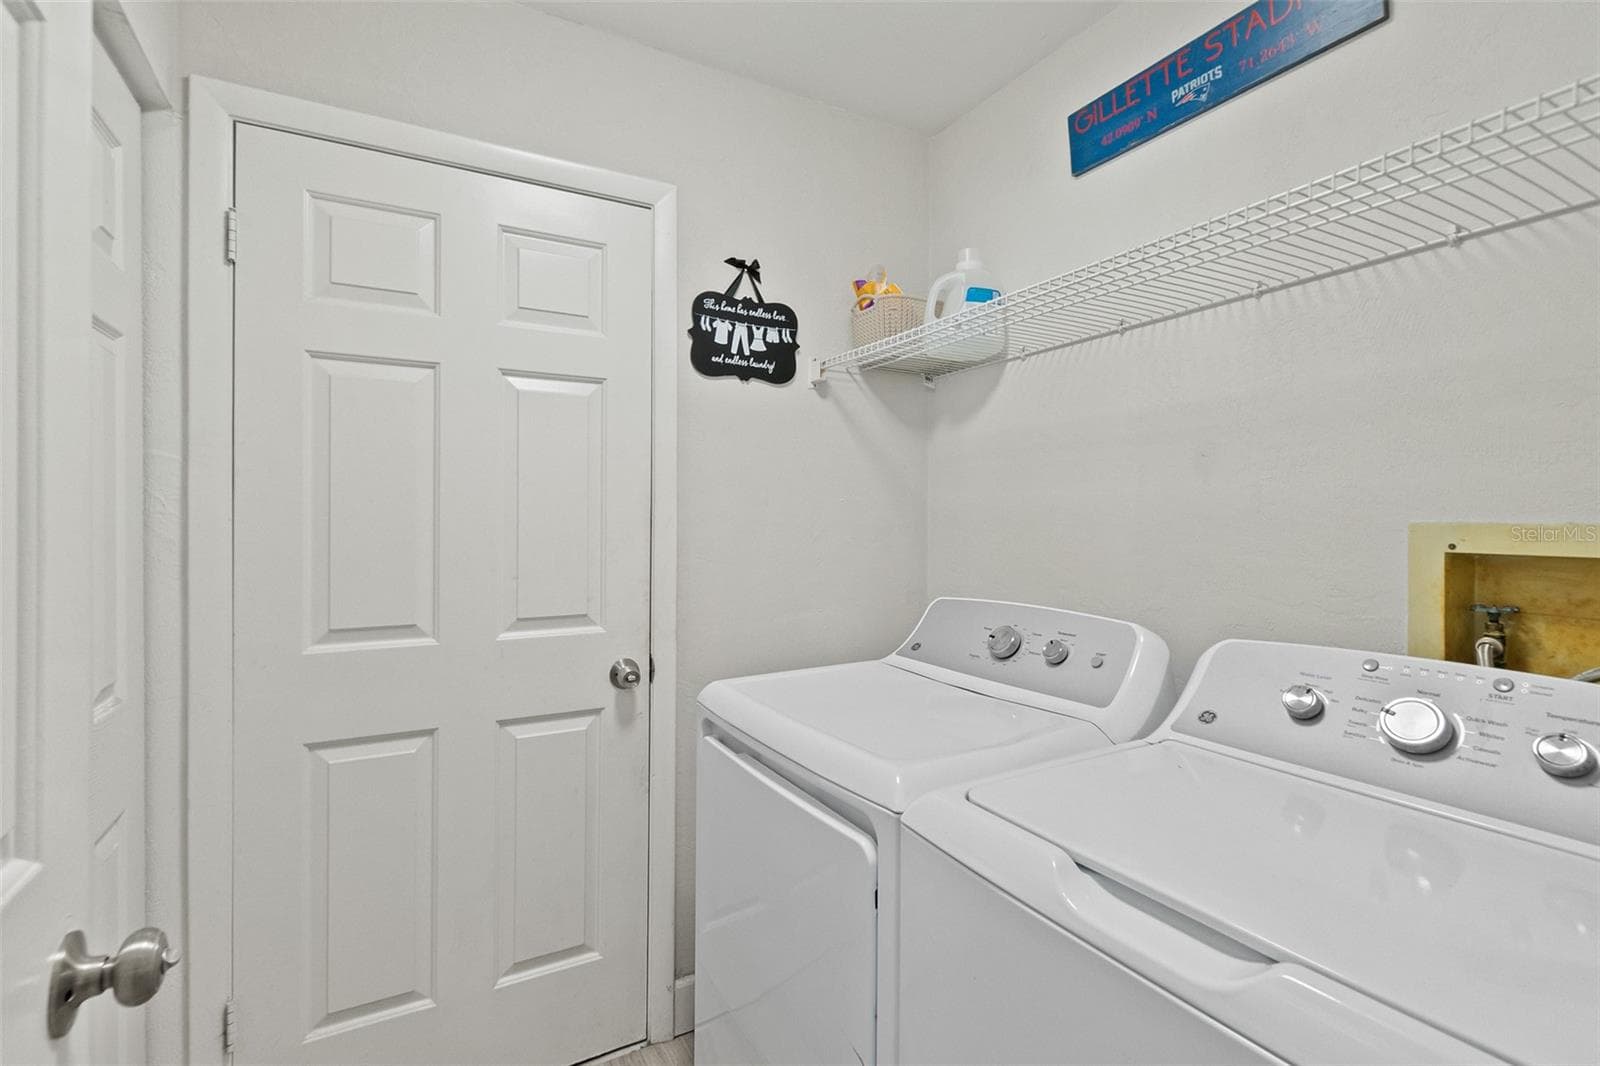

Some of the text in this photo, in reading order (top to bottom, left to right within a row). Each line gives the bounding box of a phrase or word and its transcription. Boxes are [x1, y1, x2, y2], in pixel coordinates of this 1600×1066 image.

[1074, 48, 1193, 134] GILLETTE
[1171, 65, 1223, 103] PATRIOTS
[1146, 107, 1158, 123] N
[703, 298, 720, 311] This
[720, 300, 736, 313] home
[736, 303, 748, 315] has
[749, 307, 771, 320] endless
[711, 354, 724, 363] and
[724, 355, 748, 366] endless
[1416, 689, 1441, 698] Normal
[1488, 693, 1514, 702] START
